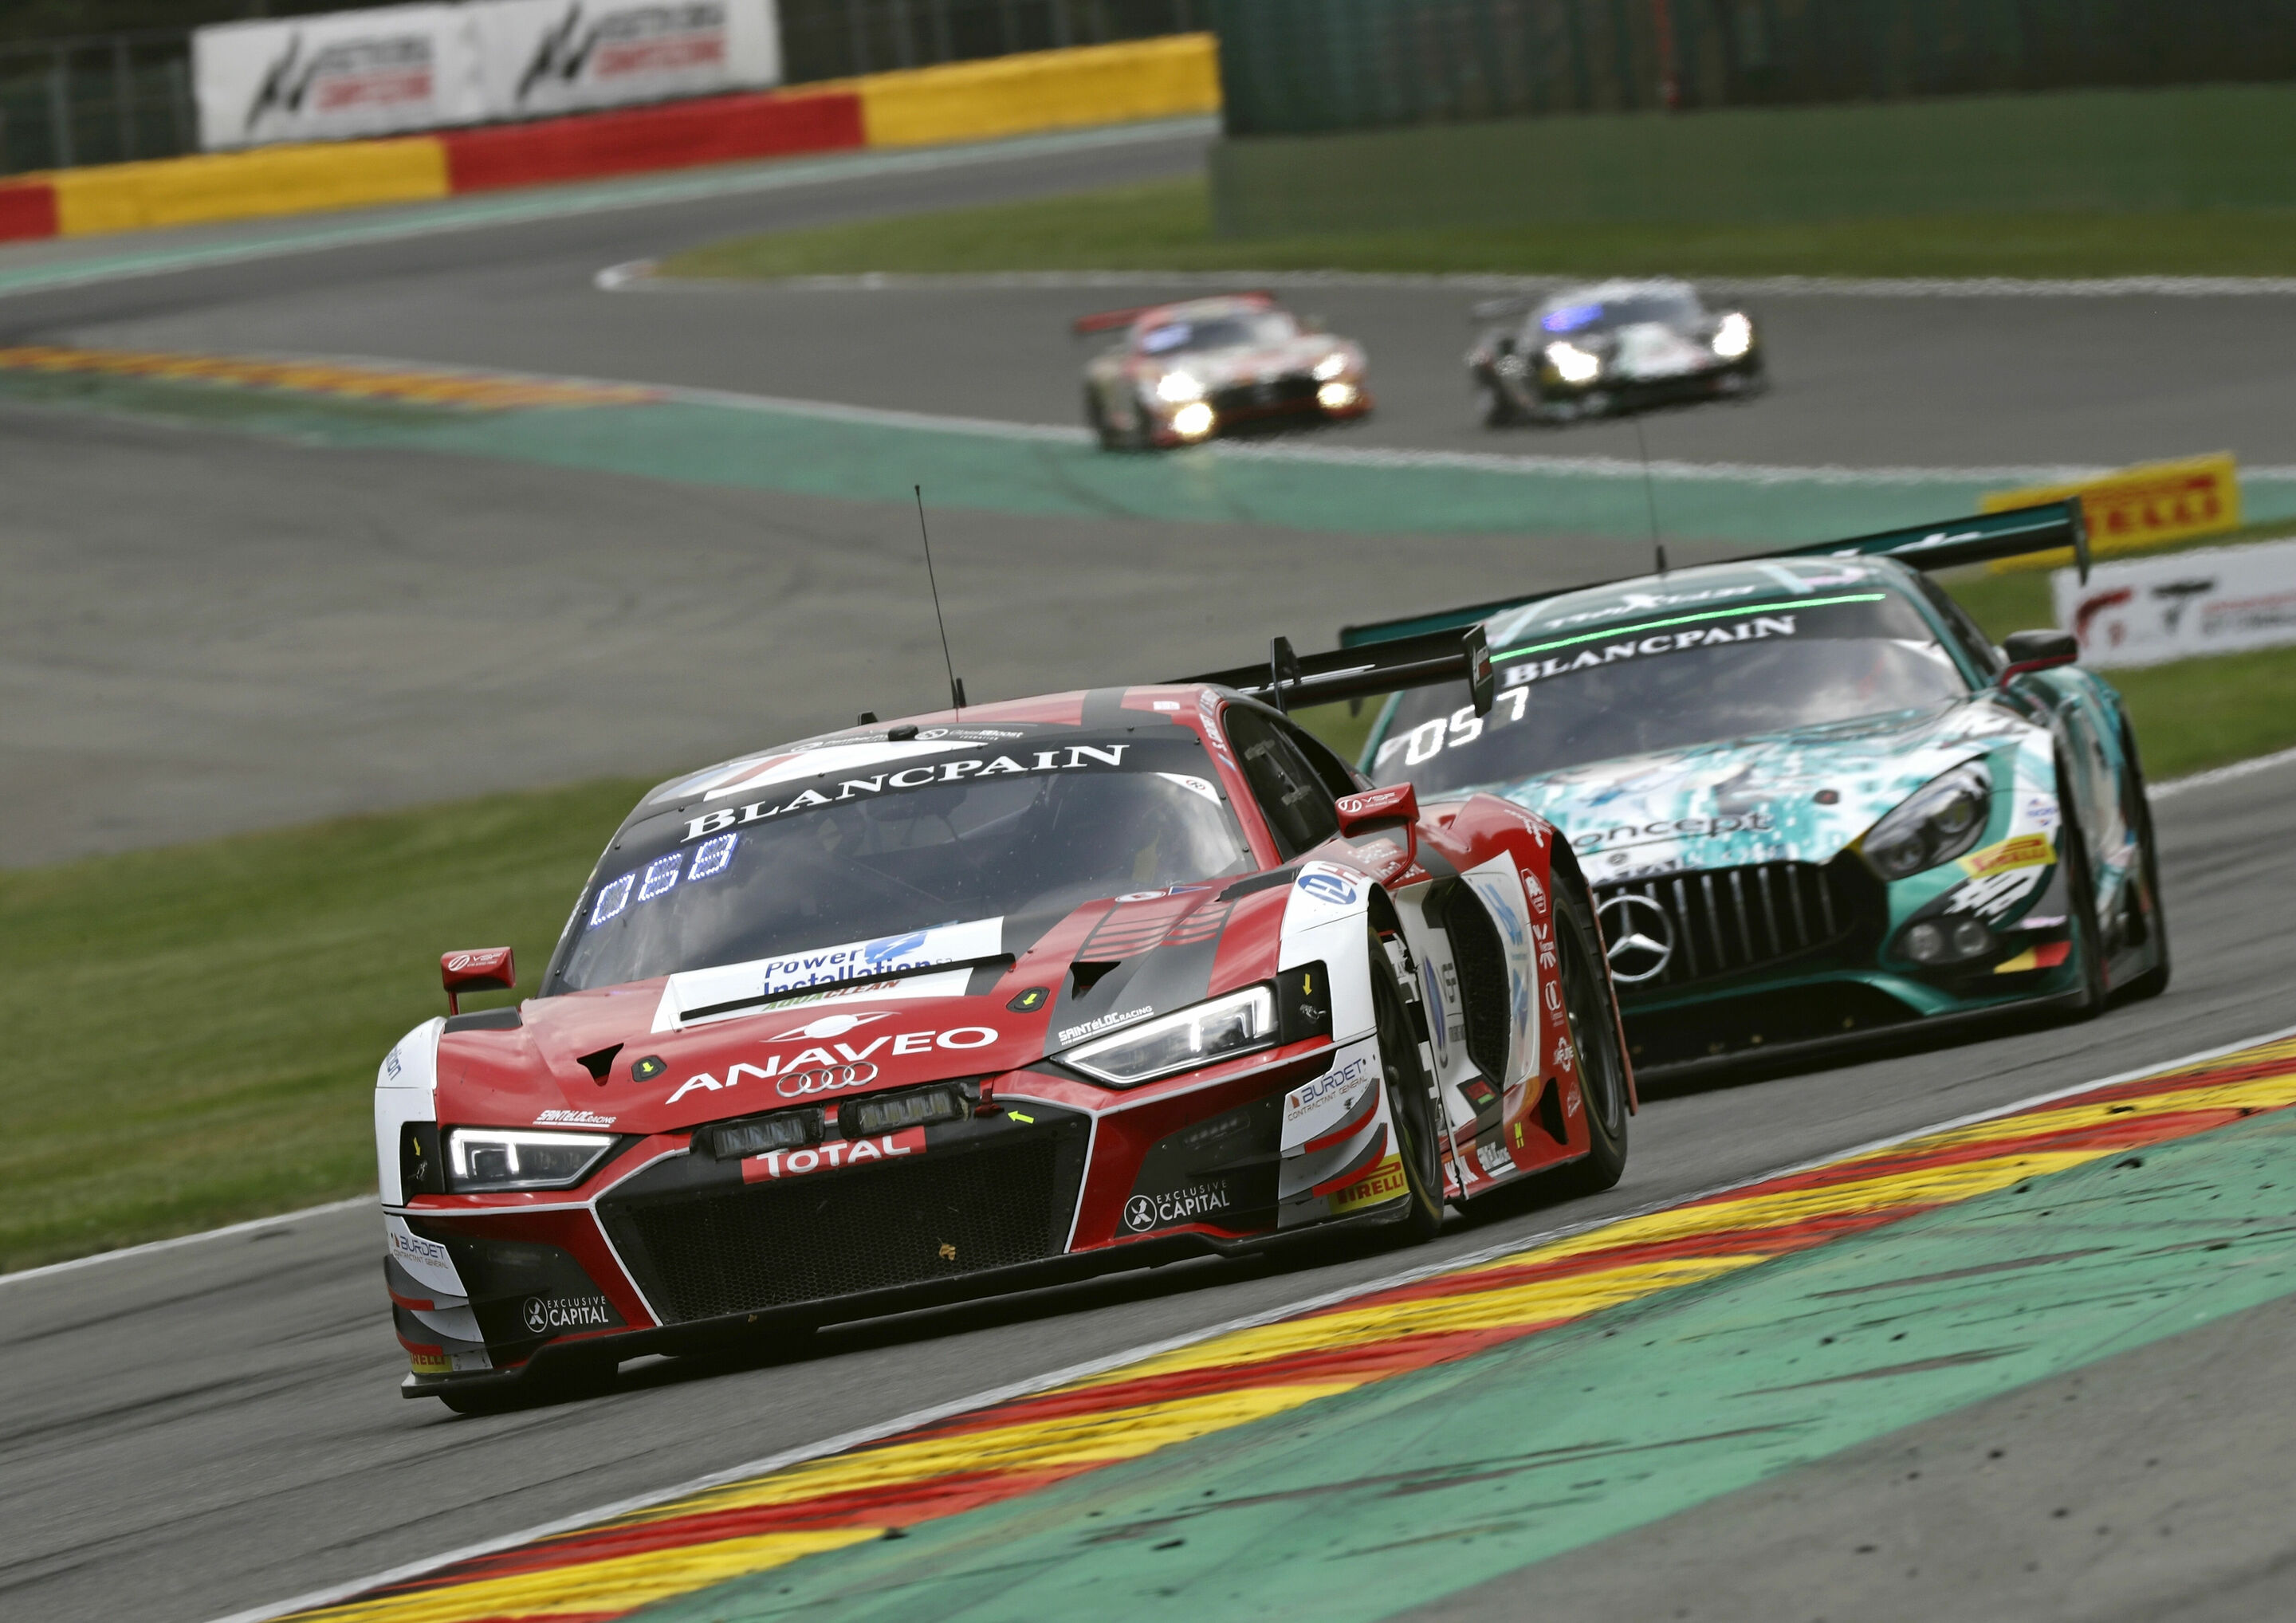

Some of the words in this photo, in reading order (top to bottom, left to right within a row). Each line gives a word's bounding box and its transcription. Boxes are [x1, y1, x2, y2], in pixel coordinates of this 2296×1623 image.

[1502, 615, 1796, 689] BLANCPAIN
[680, 745, 1130, 843] BLANCPAIN
[1572, 811, 1775, 847] oncept
[590, 832, 738, 926] 069
[765, 948, 863, 979] Power
[665, 1026, 999, 1105] ANAVEO
[1301, 1058, 1362, 1104] BURDET
[1288, 1091, 1337, 1122] CONTRACTANT
[1339, 1075, 1368, 1095] GENERAL
[756, 1135, 910, 1177] TOTAL
[1156, 1179, 1228, 1204] EXCLUSIVE
[1159, 1190, 1230, 1221] CAPITAL
[400, 1236, 445, 1259] BURDET
[547, 1295, 606, 1309] EXCLUSIVE
[549, 1306, 609, 1326] CAPITAL
